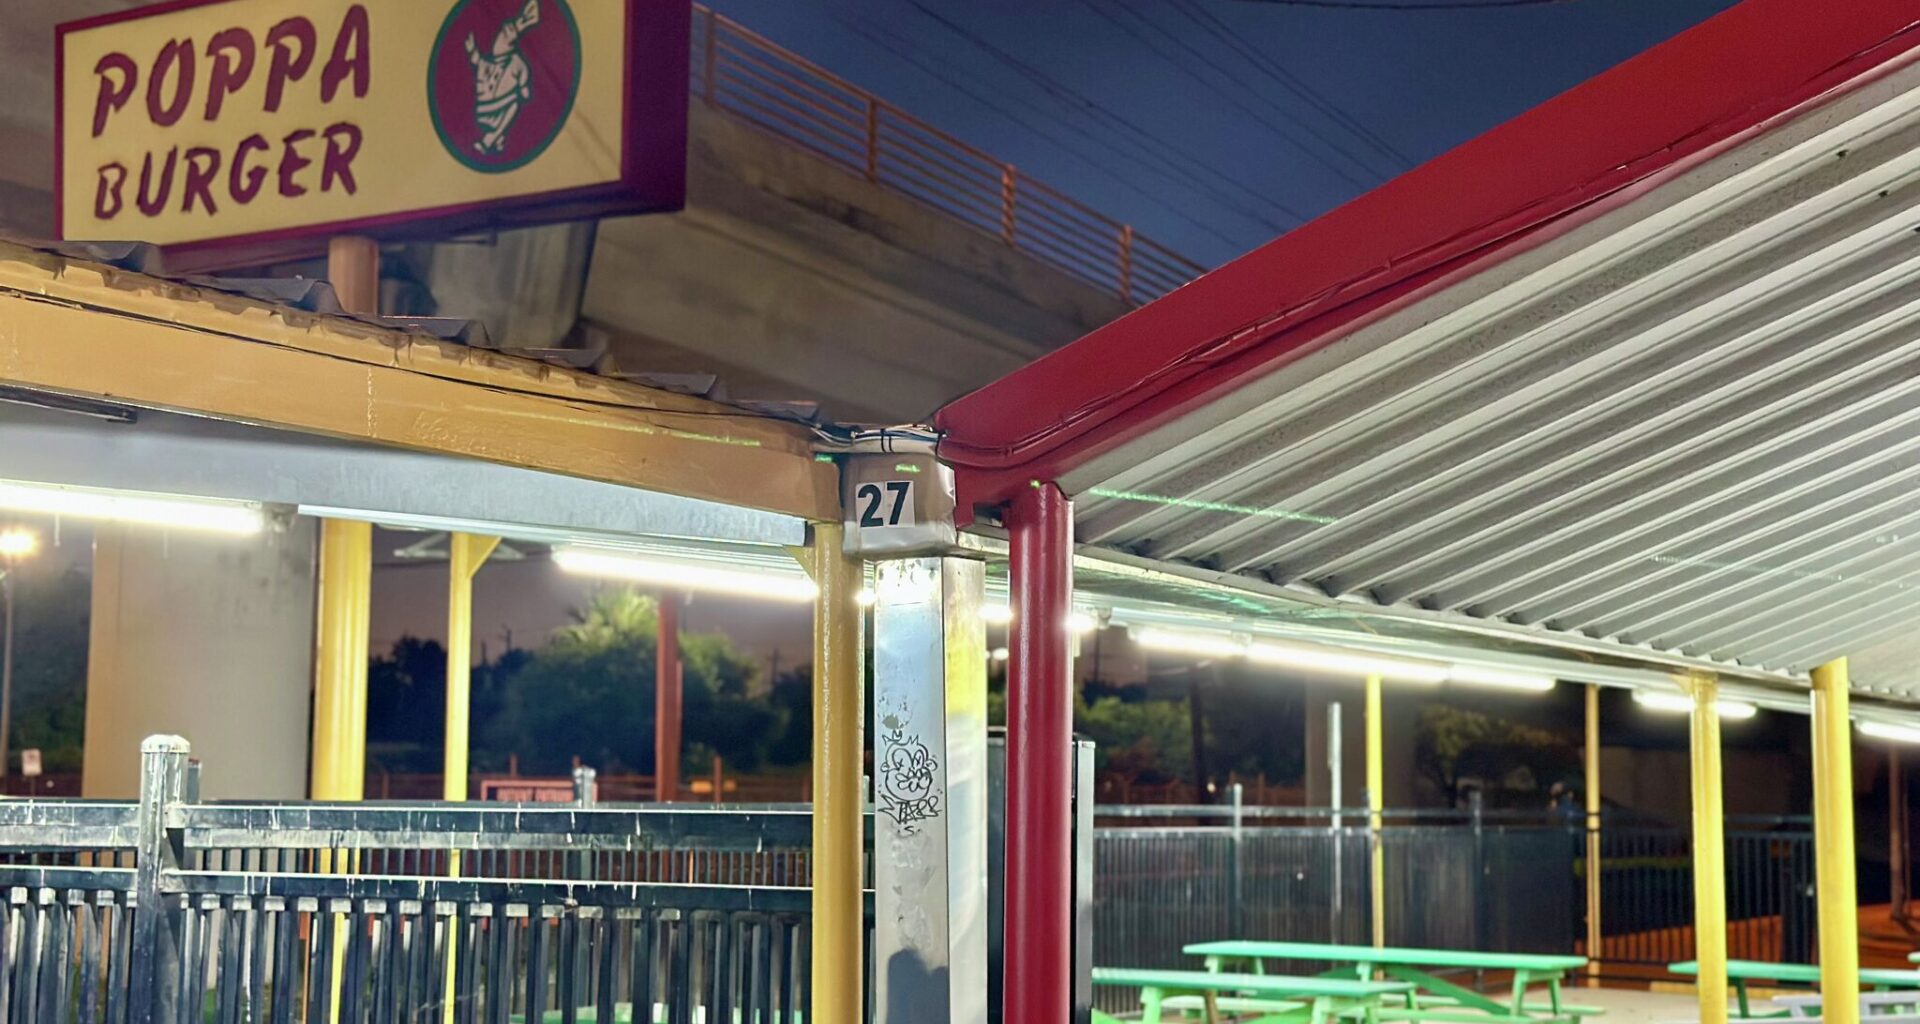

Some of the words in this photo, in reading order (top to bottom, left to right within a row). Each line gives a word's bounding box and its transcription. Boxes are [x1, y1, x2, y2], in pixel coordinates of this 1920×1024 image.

[91, 3, 371, 138] POPPA
[93, 121, 364, 220] BURGER
[857, 481, 911, 528] 27
